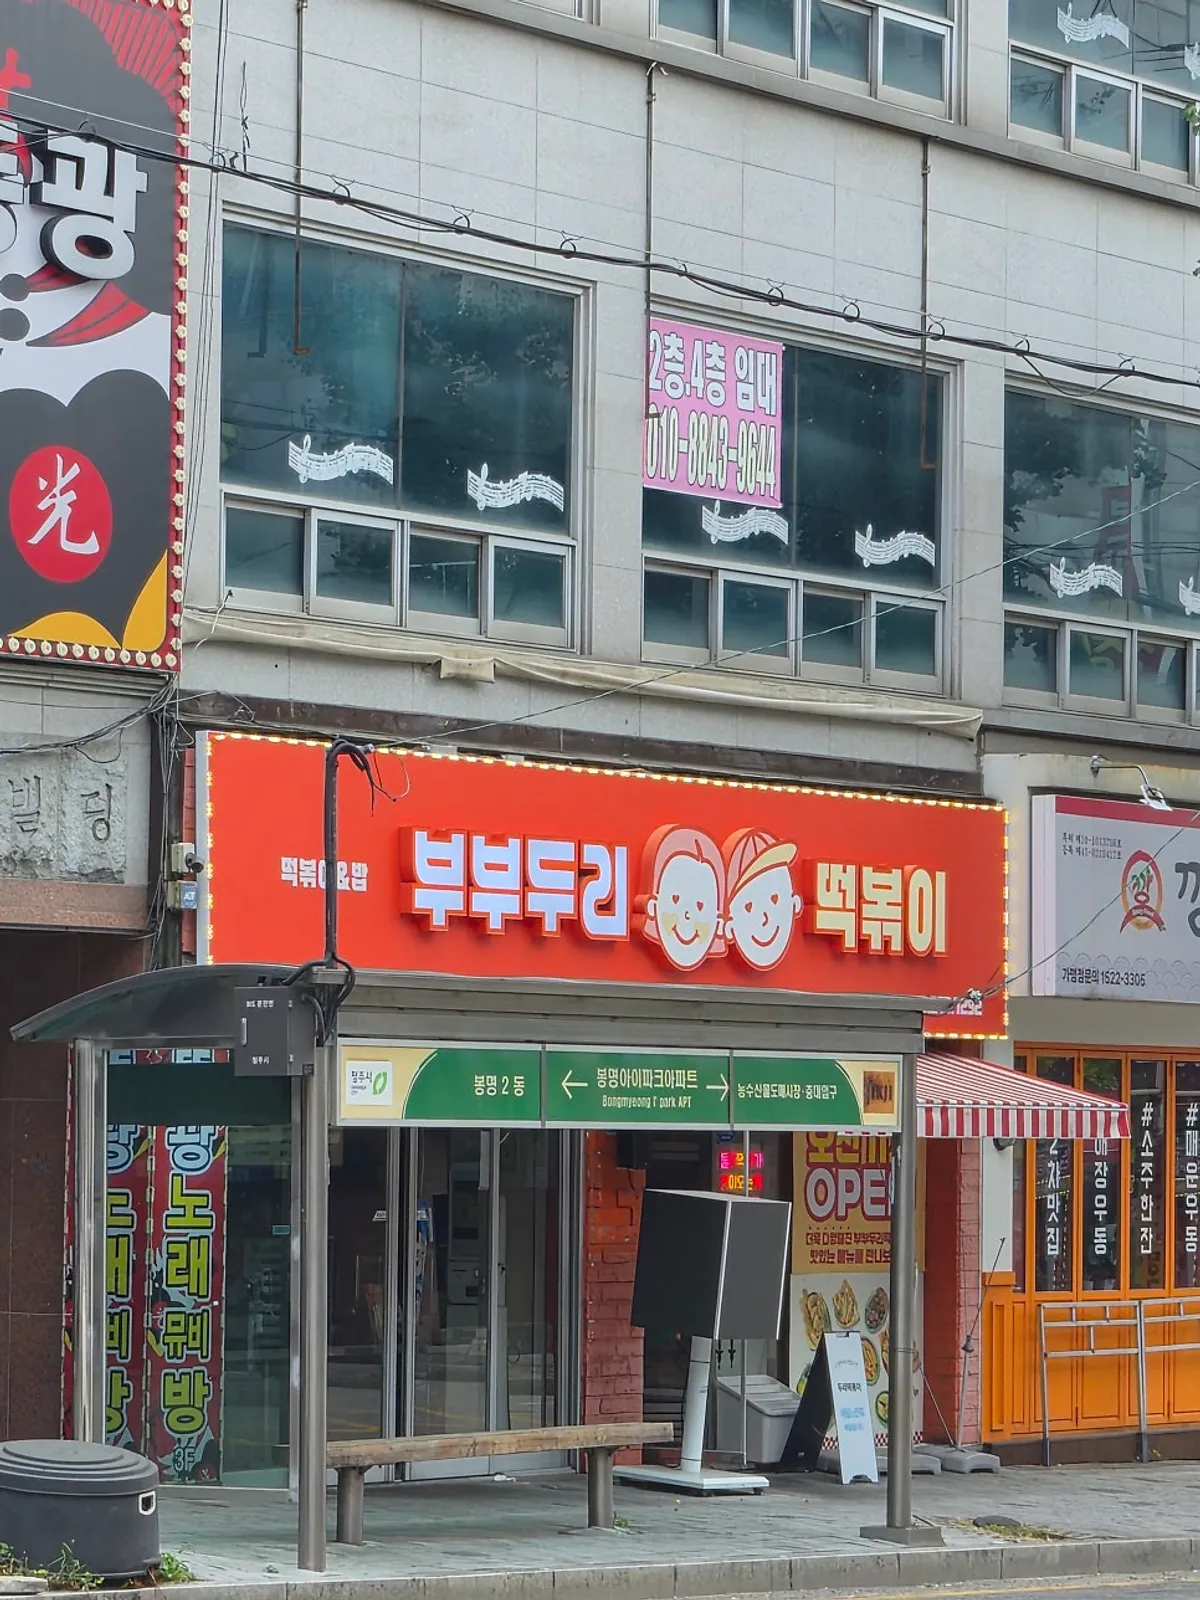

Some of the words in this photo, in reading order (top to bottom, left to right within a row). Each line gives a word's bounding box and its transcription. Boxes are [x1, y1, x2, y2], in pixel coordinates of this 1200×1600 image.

[733, 345, 778, 417] 임대
[646, 402, 776, 499] 010-8843-9644
[27, 453, 100, 555] 光
[280, 856, 368, 892] 떡볶&밥
[408, 829, 629, 938] 부부두리
[814, 861, 947, 954] 떡볶이
[1100, 971, 1146, 988] 1522-3305
[474, 1074, 497, 1096] 봉명
[501, 1075, 510, 1095] 2
[513, 1075, 525, 1097] 동
[597, 1067, 698, 1089] 봉명아이파크아파트
[678, 1095, 692, 1108] APT
[805, 1166, 891, 1219] OPE
[1140, 1101, 1154, 1254] #소주한잔
[1185, 1102, 1199, 1253] #매운우동
